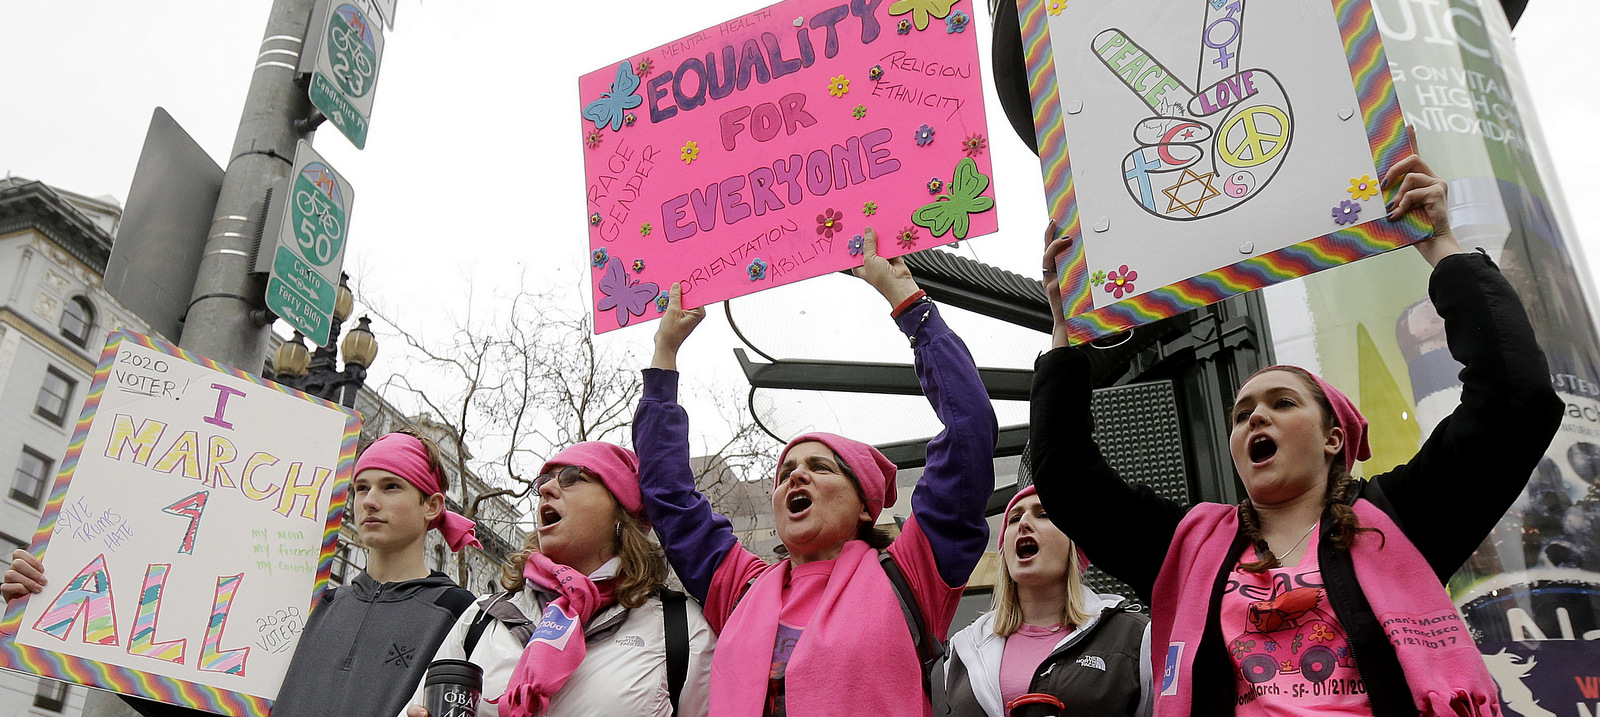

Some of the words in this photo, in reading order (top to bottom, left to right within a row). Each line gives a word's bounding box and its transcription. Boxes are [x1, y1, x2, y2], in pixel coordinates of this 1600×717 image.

[661, 33, 711, 61] MENTAL
[719, 9, 772, 36] HEALTH
[332, 52, 364, 96] 23
[879, 50, 971, 79] RELIGION
[1097, 33, 1181, 109] PEACE
[316, 75, 356, 122] Candlestick
[871, 80, 965, 122] ETHNICITY
[1199, 71, 1258, 115] LOVE
[719, 93, 817, 151] FOR
[588, 138, 635, 208] RACE
[599, 144, 661, 243] GENDER
[661, 128, 901, 243] EVERYONE
[298, 218, 332, 263] 50
[681, 218, 798, 295] ORIENTATION
[770, 233, 834, 283] ABILITY
[293, 260, 320, 288] Castro
[279, 285, 301, 311] Ferry
[303, 304, 322, 328] Bldg
[120, 351, 169, 373] 2020
[203, 383, 247, 431] I
[104, 413, 332, 522] MARCH
[72, 507, 122, 543] TRUMPS
[103, 519, 134, 553] HATE
[32, 553, 251, 678] ALL
[256, 606, 299, 633] 2020
[1402, 626, 1459, 638] Francisco
